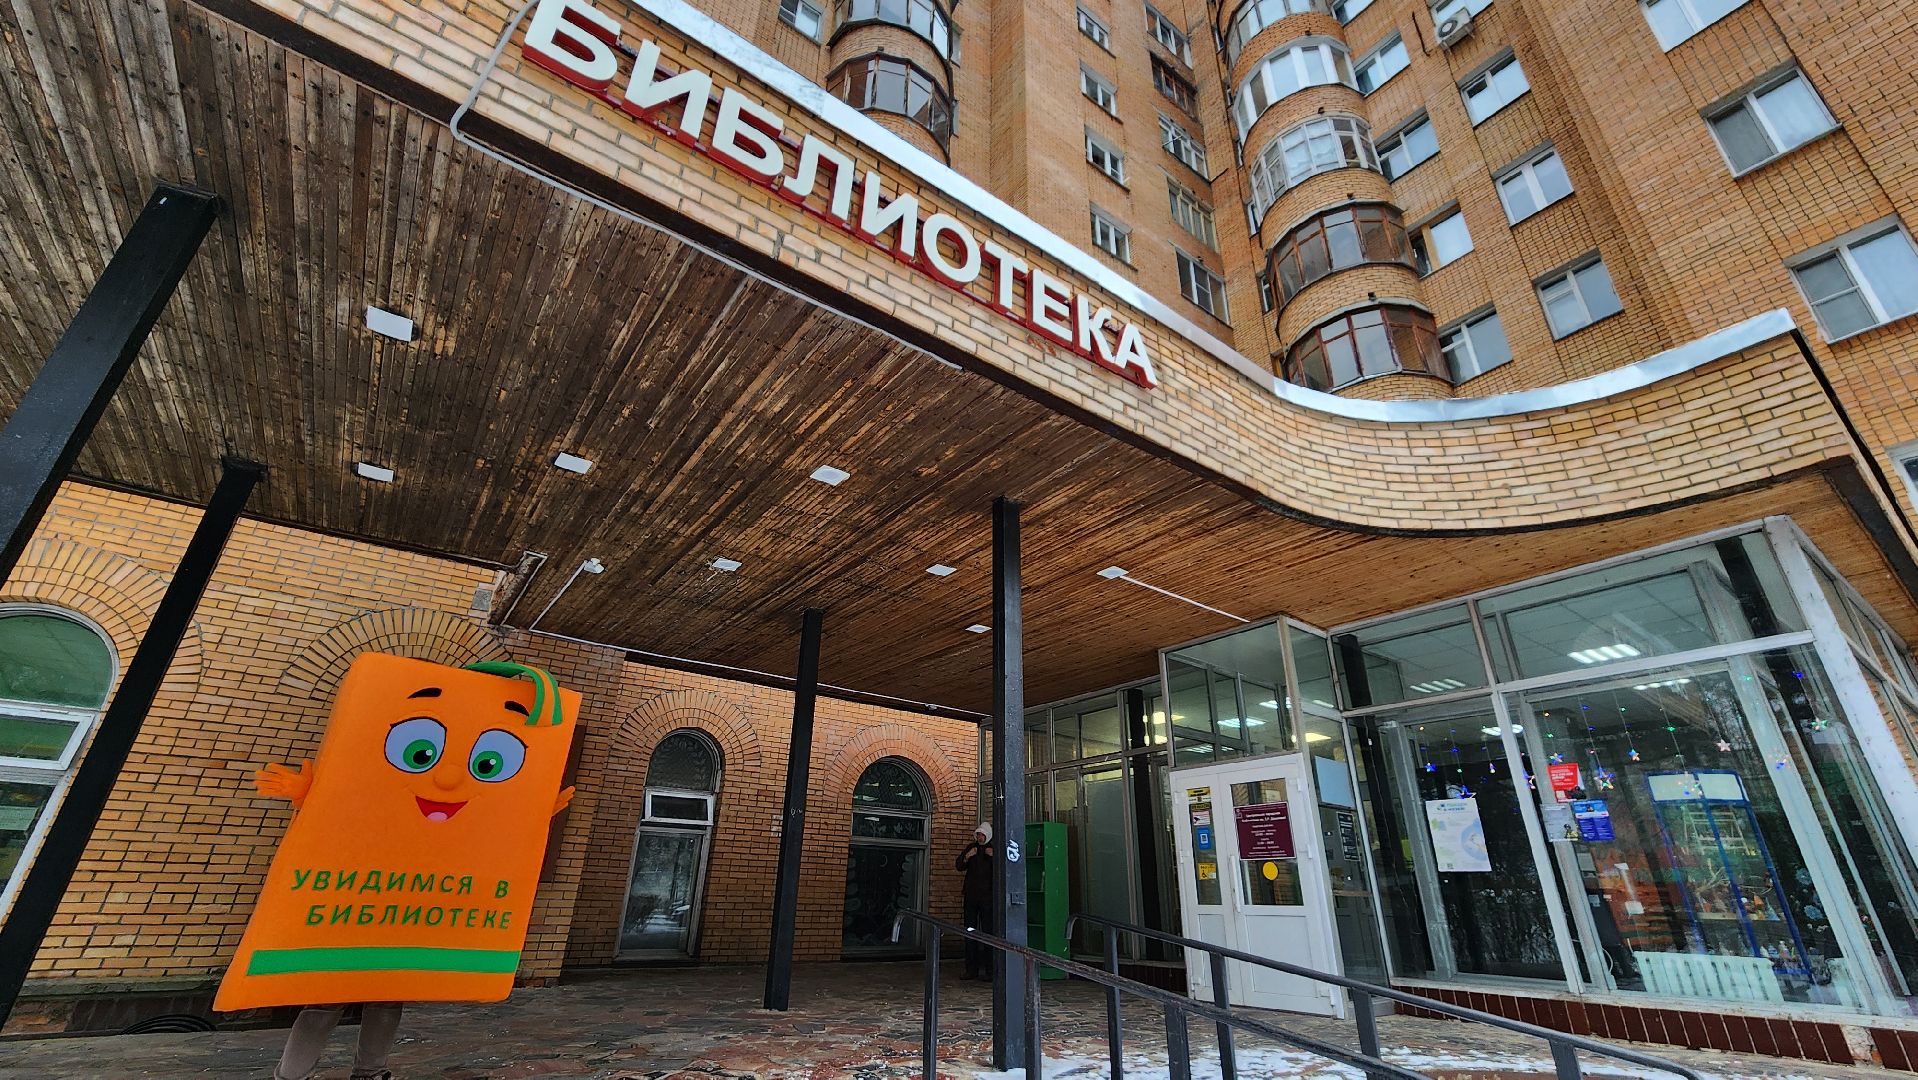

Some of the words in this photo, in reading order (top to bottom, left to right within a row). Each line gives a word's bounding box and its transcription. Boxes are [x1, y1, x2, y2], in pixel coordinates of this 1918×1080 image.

[522, 0, 1158, 390] БИБЛИОТЕКА
[290, 868, 473, 895] УВИДИМСЯ
[495, 879, 509, 899] В
[305, 903, 513, 930] БИБЛИОТЕКЕ
